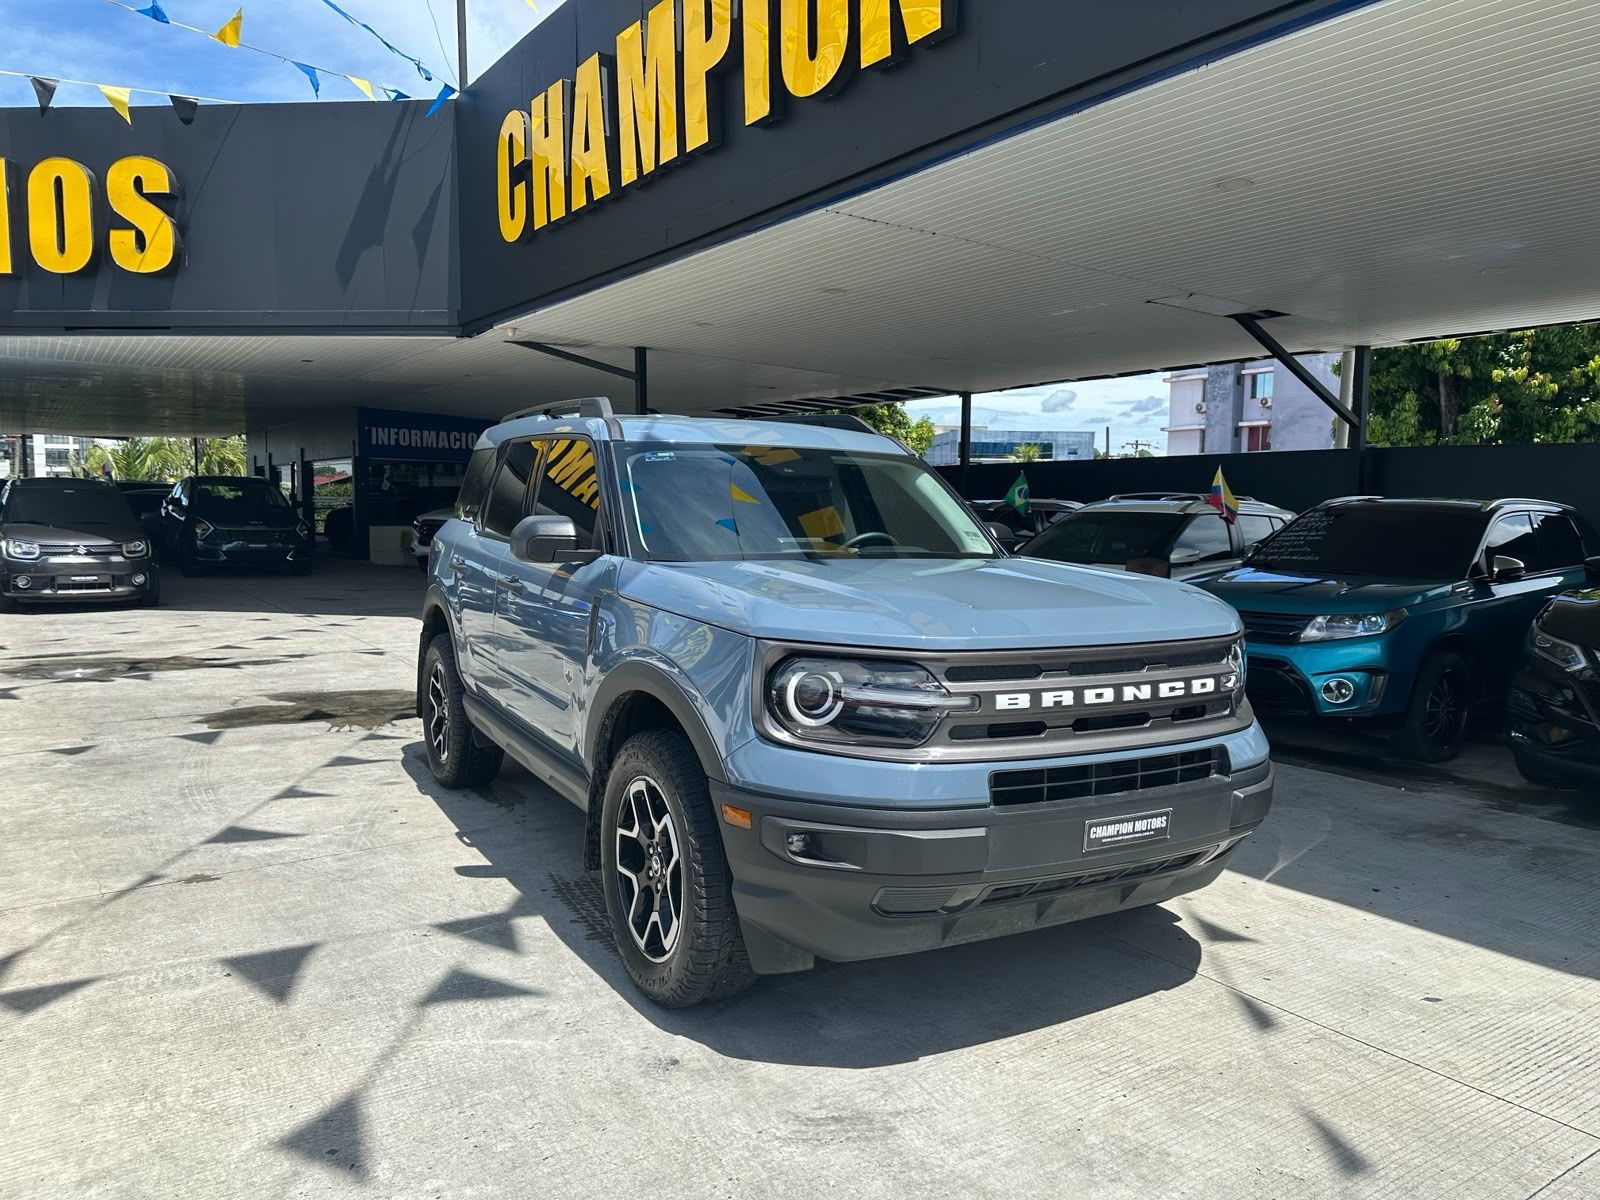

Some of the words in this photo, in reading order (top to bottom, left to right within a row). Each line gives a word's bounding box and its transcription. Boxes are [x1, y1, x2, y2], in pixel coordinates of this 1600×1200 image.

[0, 155, 175, 274] OS
[370, 426, 479, 450] INFORMACIO
[995, 677, 1215, 710] BRONCO
[1089, 820, 1134, 839] CHAMPION
[1134, 816, 1167, 832] MOTORS
